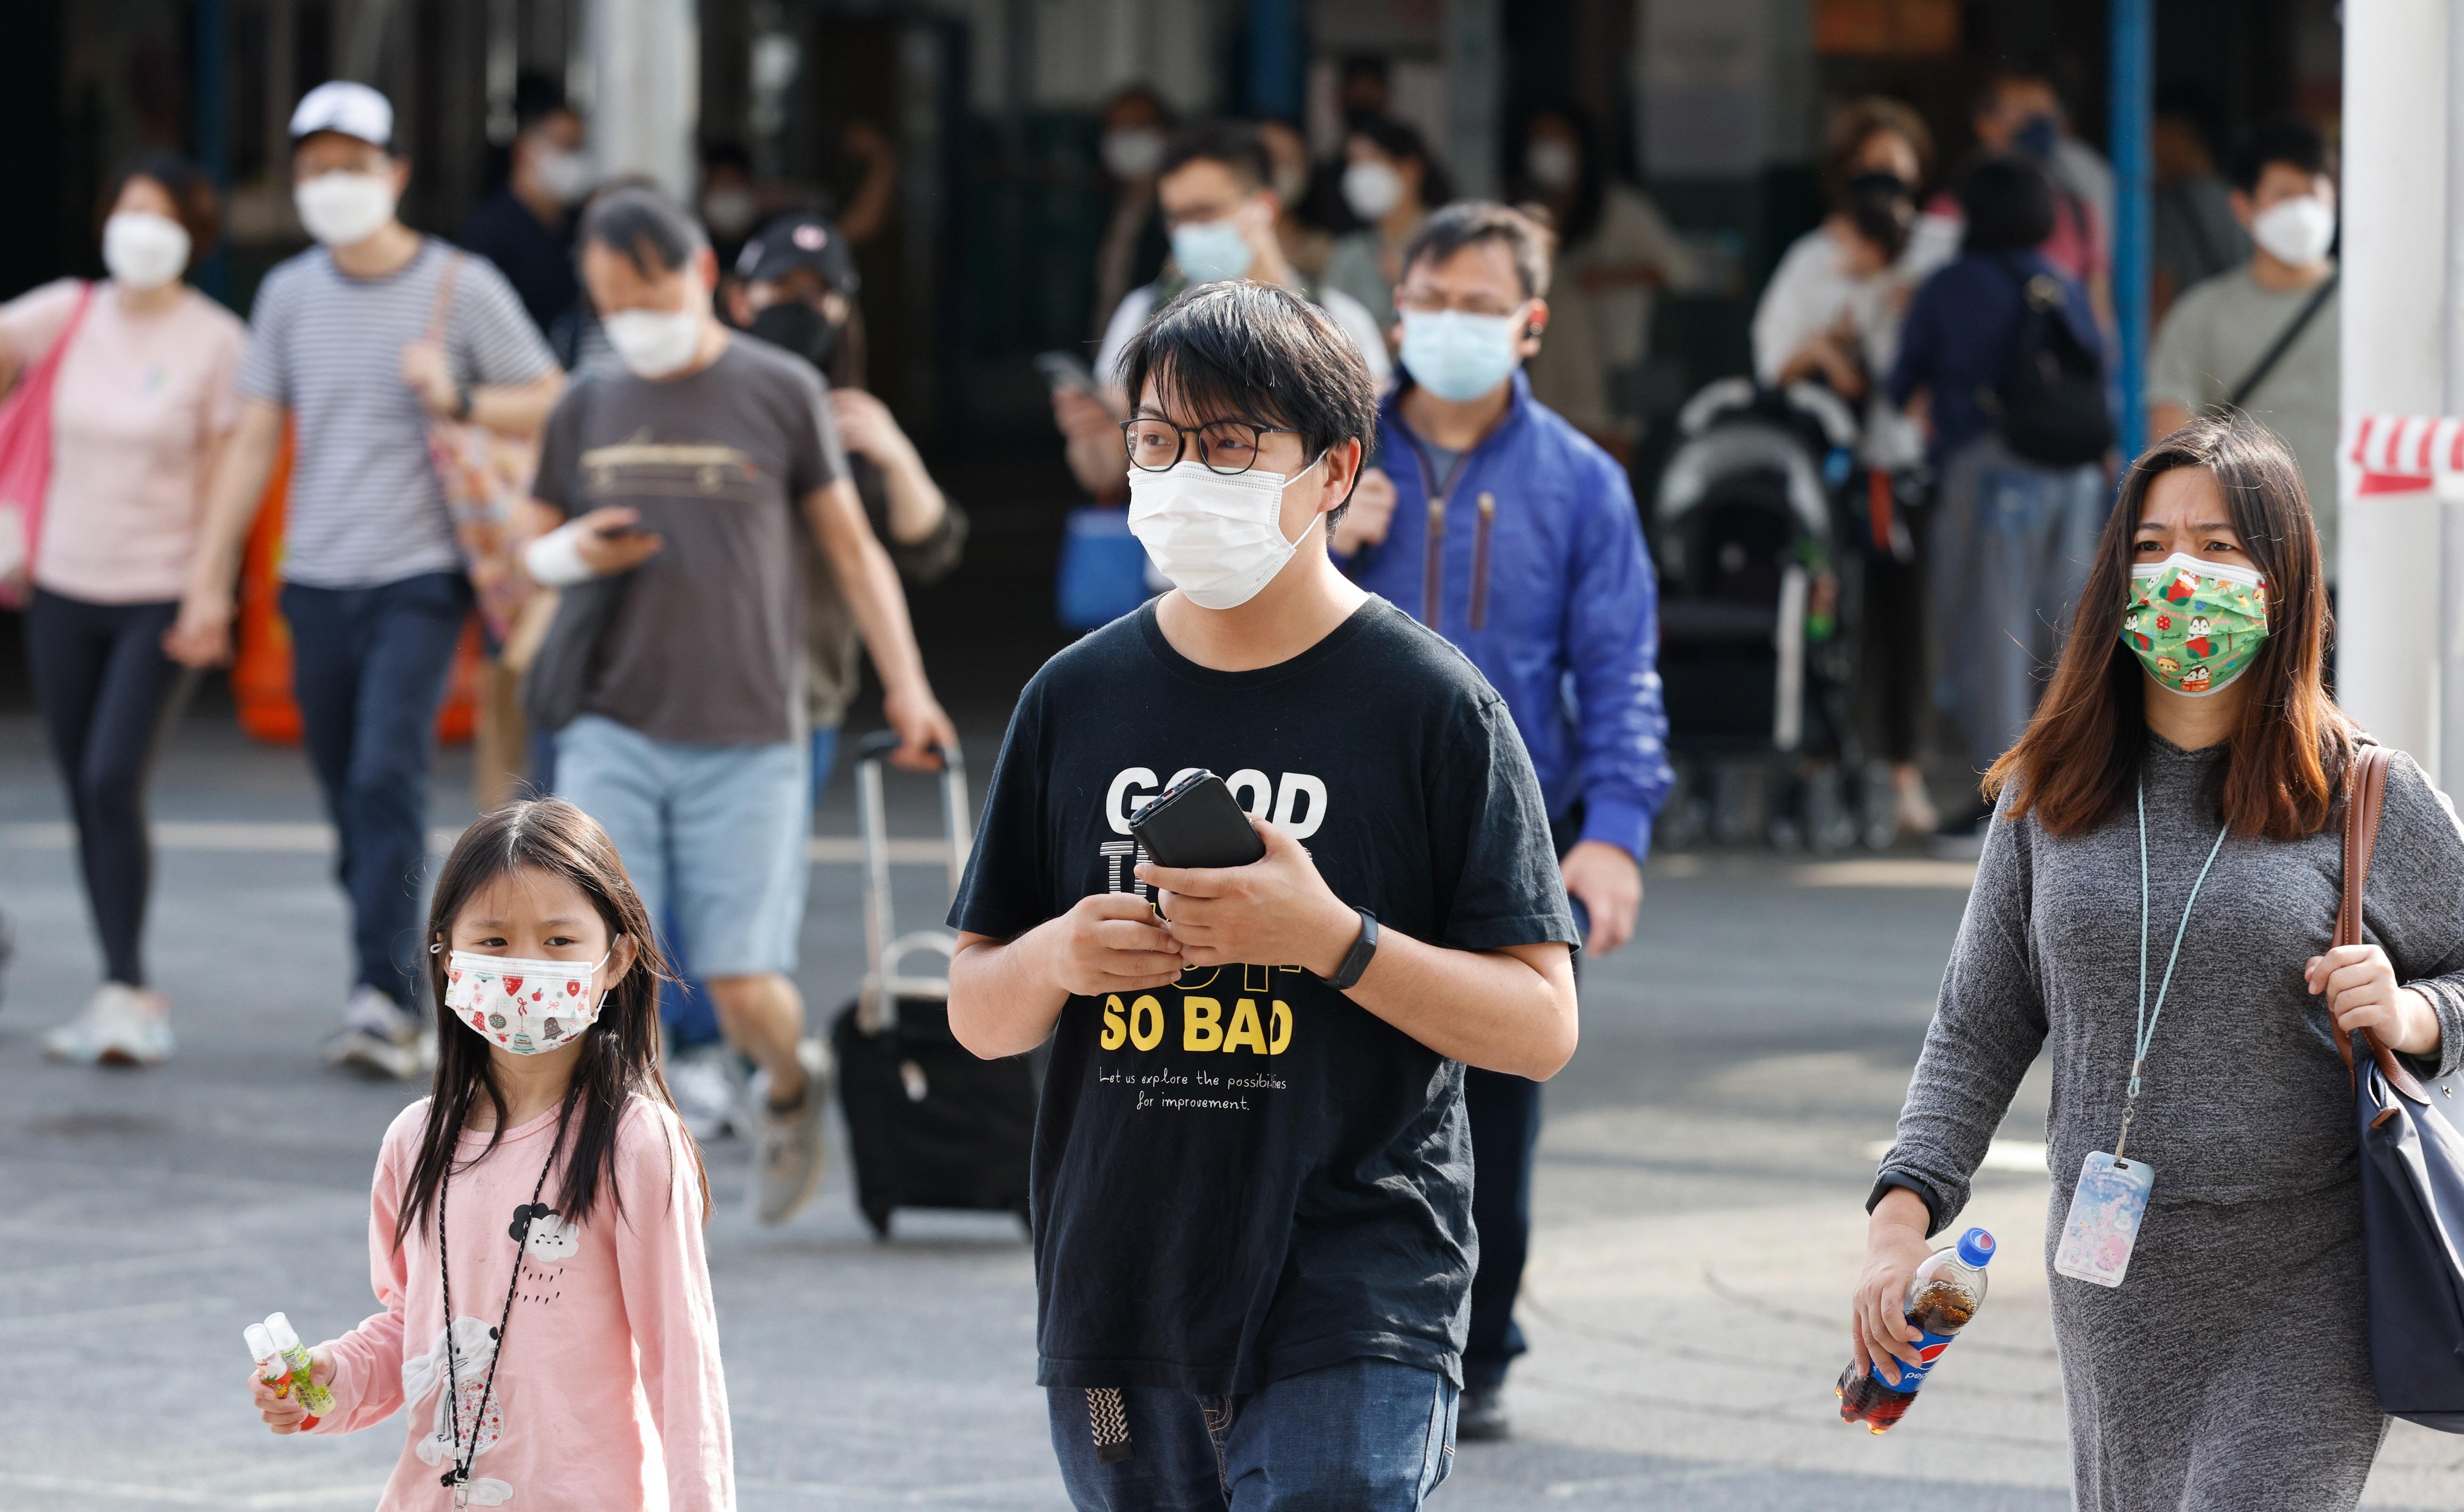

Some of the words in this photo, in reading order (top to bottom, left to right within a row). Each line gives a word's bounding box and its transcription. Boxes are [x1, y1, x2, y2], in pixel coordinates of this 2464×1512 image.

[1106, 766, 1328, 840] GOD
[1099, 994, 1165, 1051] SO
[1183, 996, 1293, 1055] BAD
[1099, 1066, 1121, 1083] Let
[1126, 1075, 1135, 1084] us
[1142, 1067, 1188, 1087] explore
[1196, 1070, 1219, 1086] the
[1136, 1090, 1154, 1110] for
[1161, 1091, 1249, 1110] improvement.
[1904, 1372, 1930, 1380] pep
